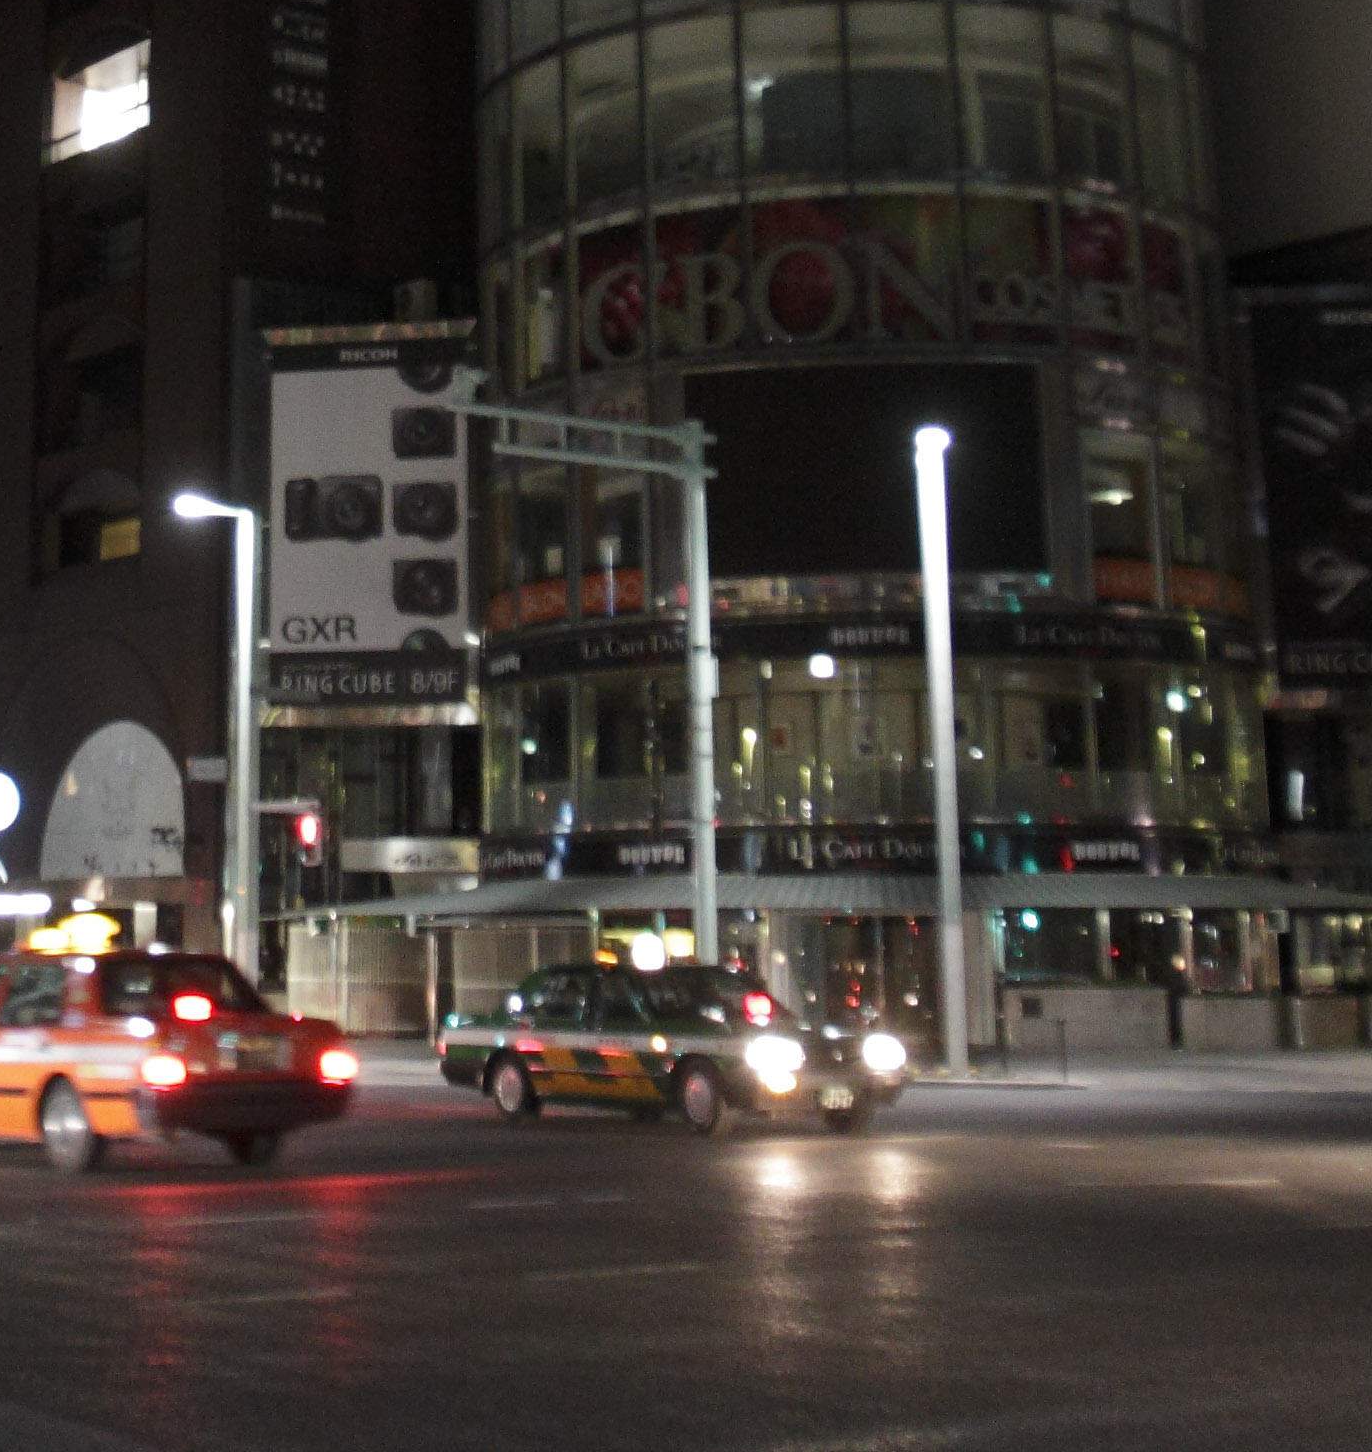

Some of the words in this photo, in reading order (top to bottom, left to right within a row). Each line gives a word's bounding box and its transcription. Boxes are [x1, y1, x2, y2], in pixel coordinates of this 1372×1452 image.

[281, 616, 358, 645] GXR
[1286, 651, 1349, 675] RING
[279, 674, 334, 697] RING
[338, 671, 395, 696] CUBE
